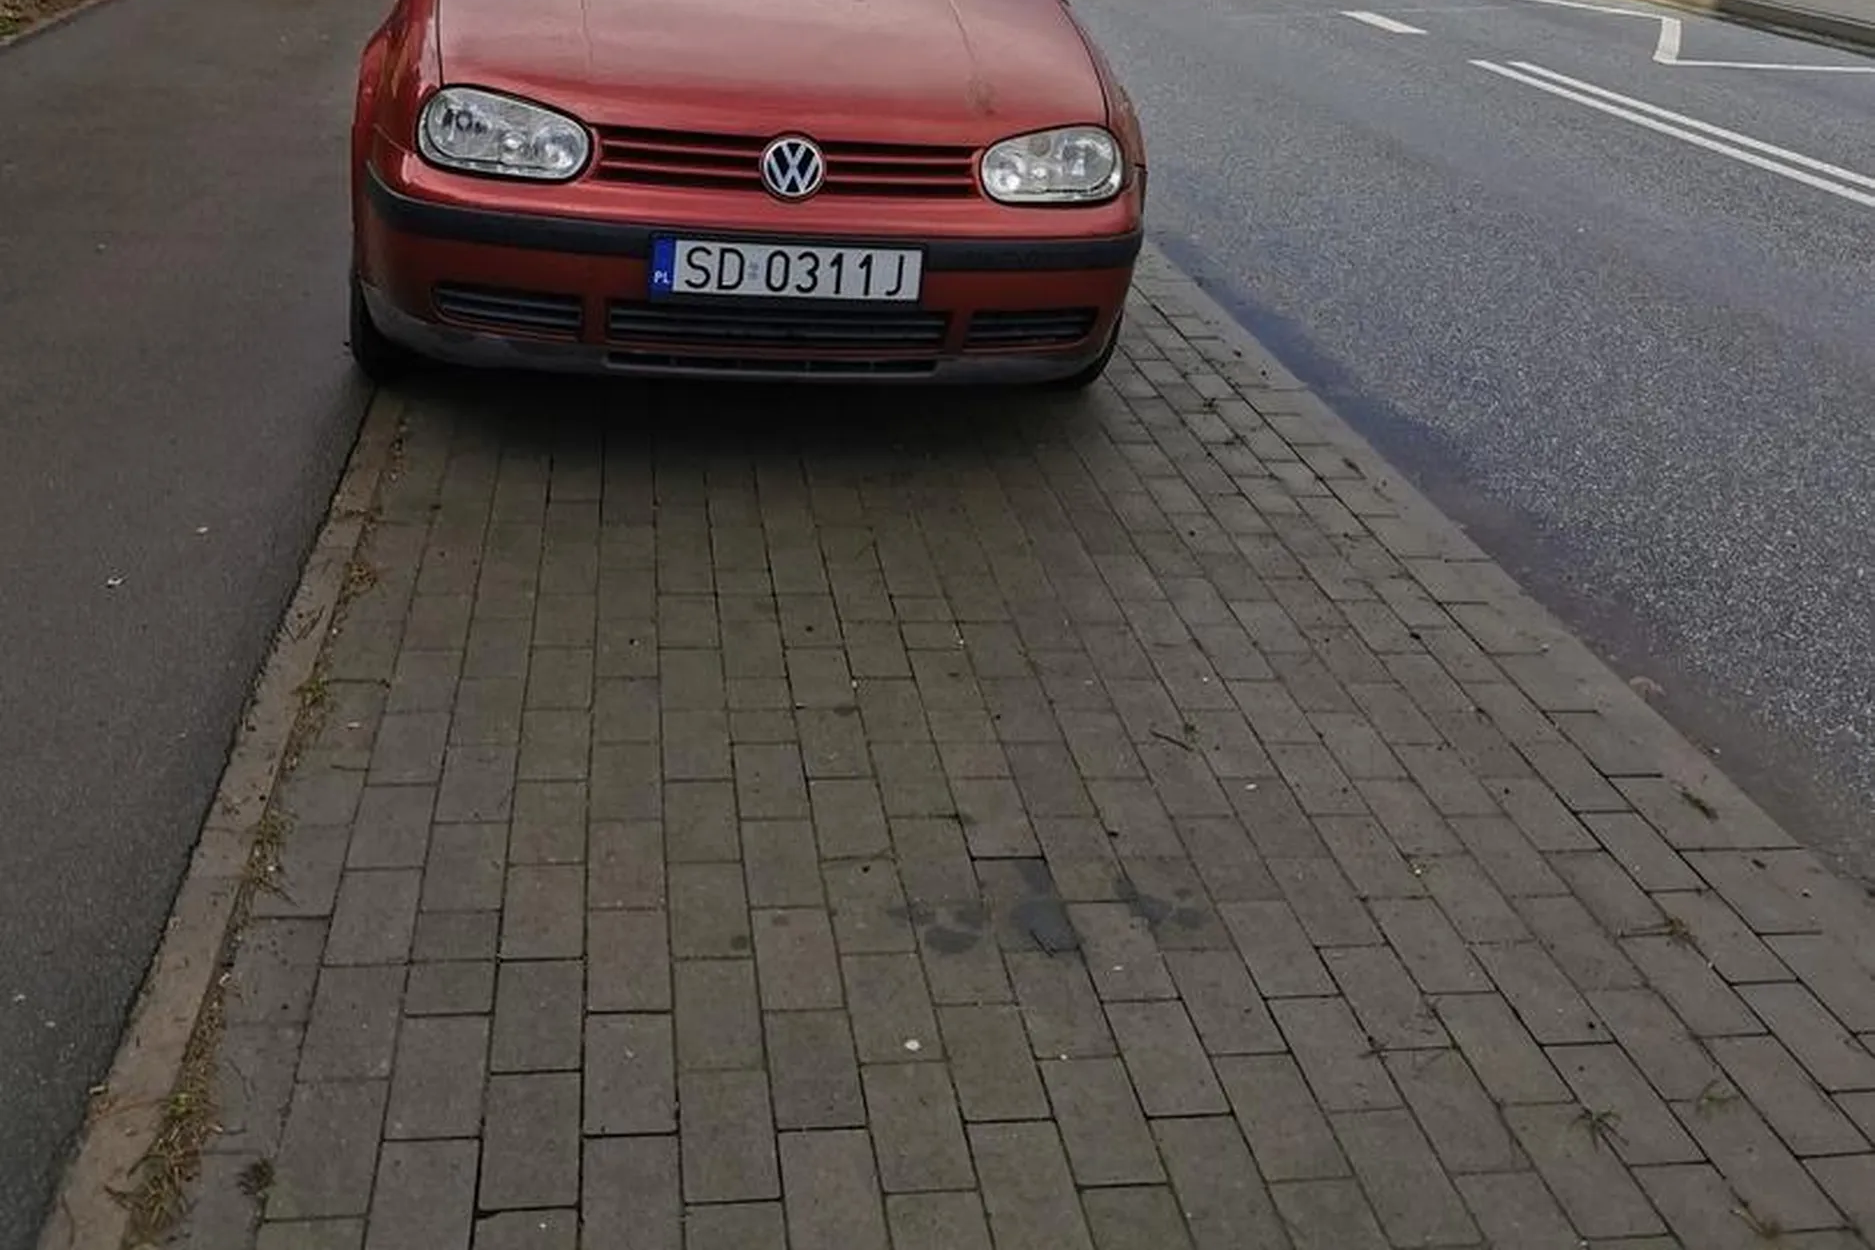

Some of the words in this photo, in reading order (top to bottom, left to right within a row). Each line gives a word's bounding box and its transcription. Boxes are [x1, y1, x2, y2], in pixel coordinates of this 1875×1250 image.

[653, 270, 671, 285] PL
[684, 246, 745, 290] SD
[765, 250, 905, 297] 0311J
